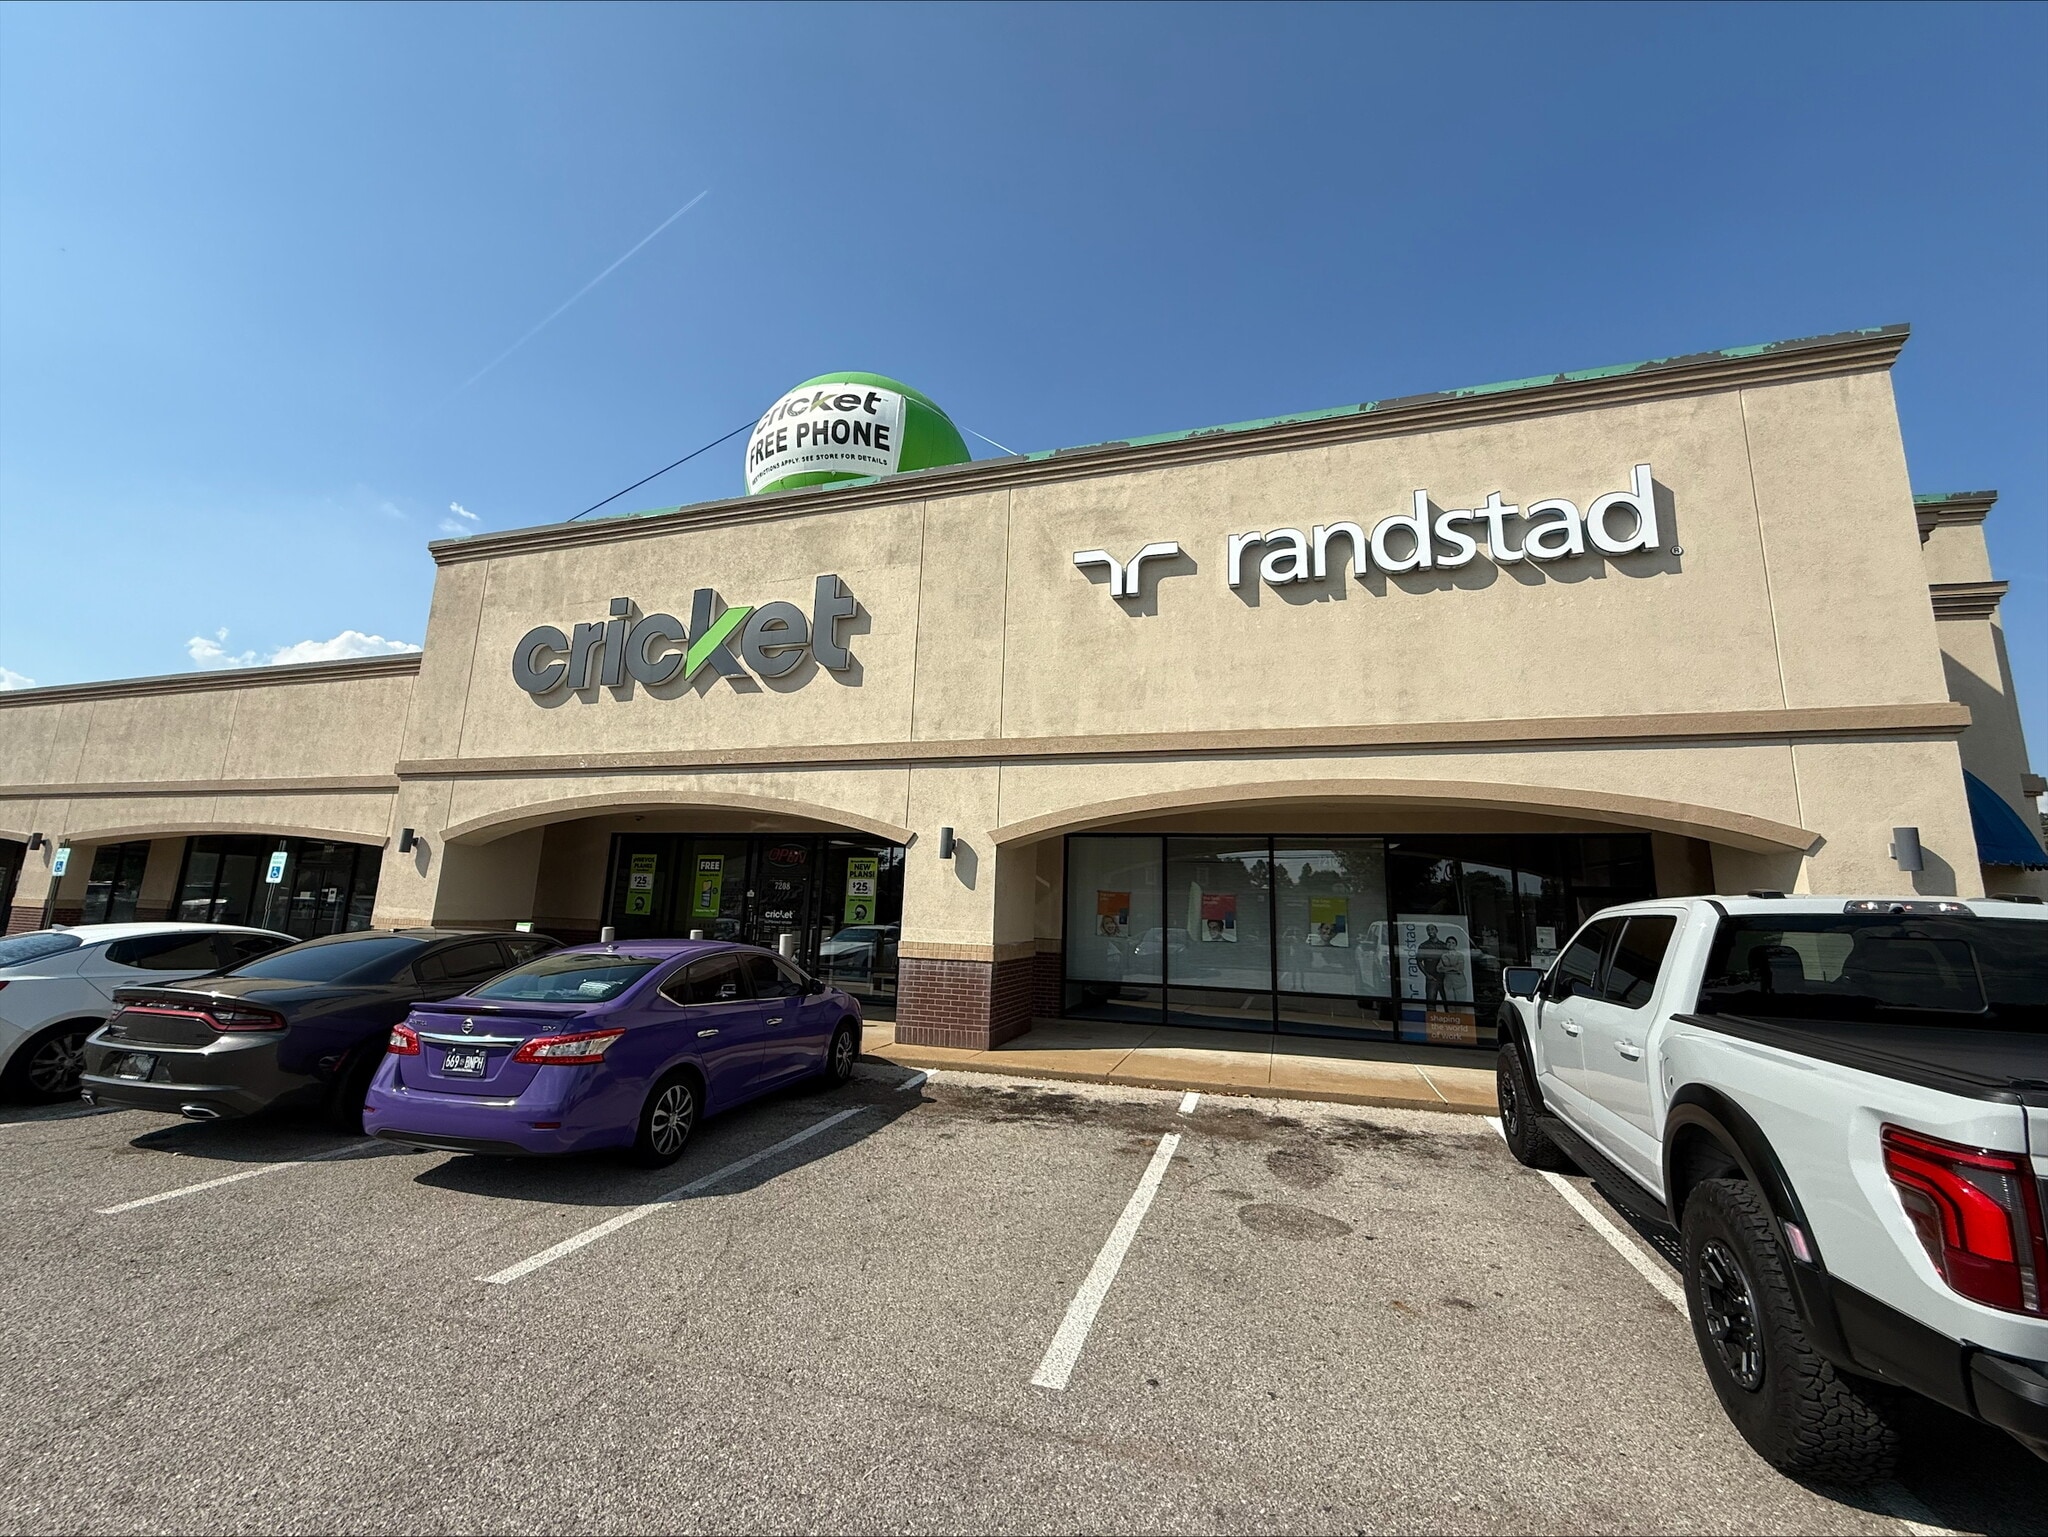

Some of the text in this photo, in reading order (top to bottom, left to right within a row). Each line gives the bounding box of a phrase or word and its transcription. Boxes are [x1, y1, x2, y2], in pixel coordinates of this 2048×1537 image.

[750, 419, 890, 473] FREE PHONE
[802, 455, 814, 463] SEE
[858, 455, 888, 466] DETAILS
[1228, 464, 1660, 588] randstad
[512, 574, 858, 694] cricket
[769, 848, 807, 864] OPEN
[700, 861, 720, 870] FREE
[634, 876, 647, 885] $25
[852, 882, 868, 891] $25
[765, 910, 793, 919] cricket
[1430, 1015, 1460, 1024] shaping
[445, 1055, 484, 1069] 669 BNPH
